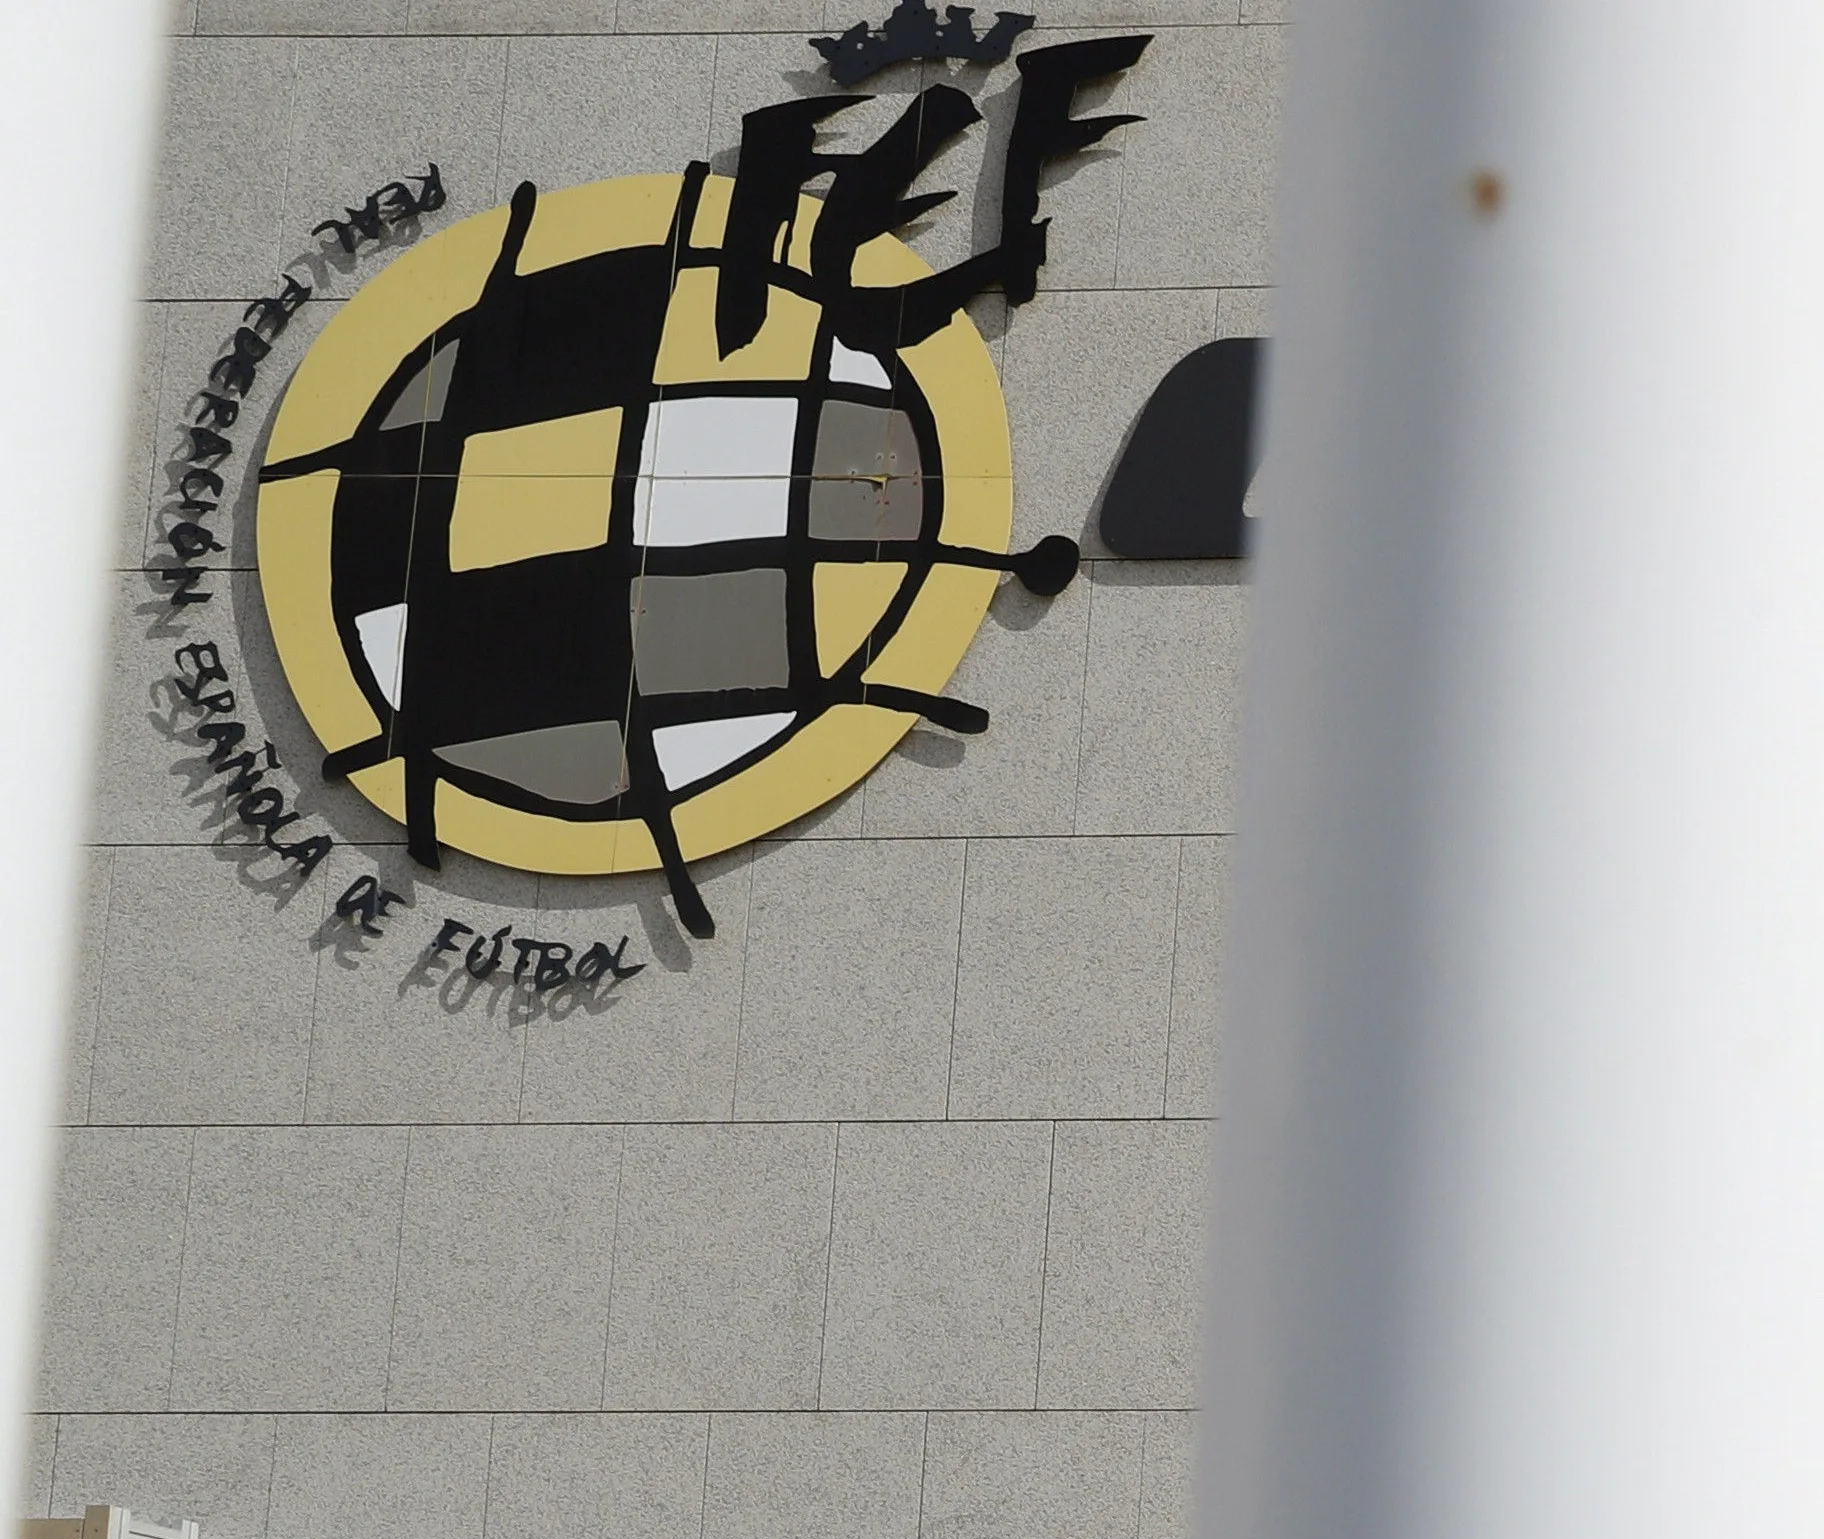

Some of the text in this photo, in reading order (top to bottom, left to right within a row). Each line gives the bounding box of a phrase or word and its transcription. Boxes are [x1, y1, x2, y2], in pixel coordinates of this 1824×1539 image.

[162, 162, 648, 992] REAL FEDERACIÓN ESPAÑOLA DE FÚTBOL
